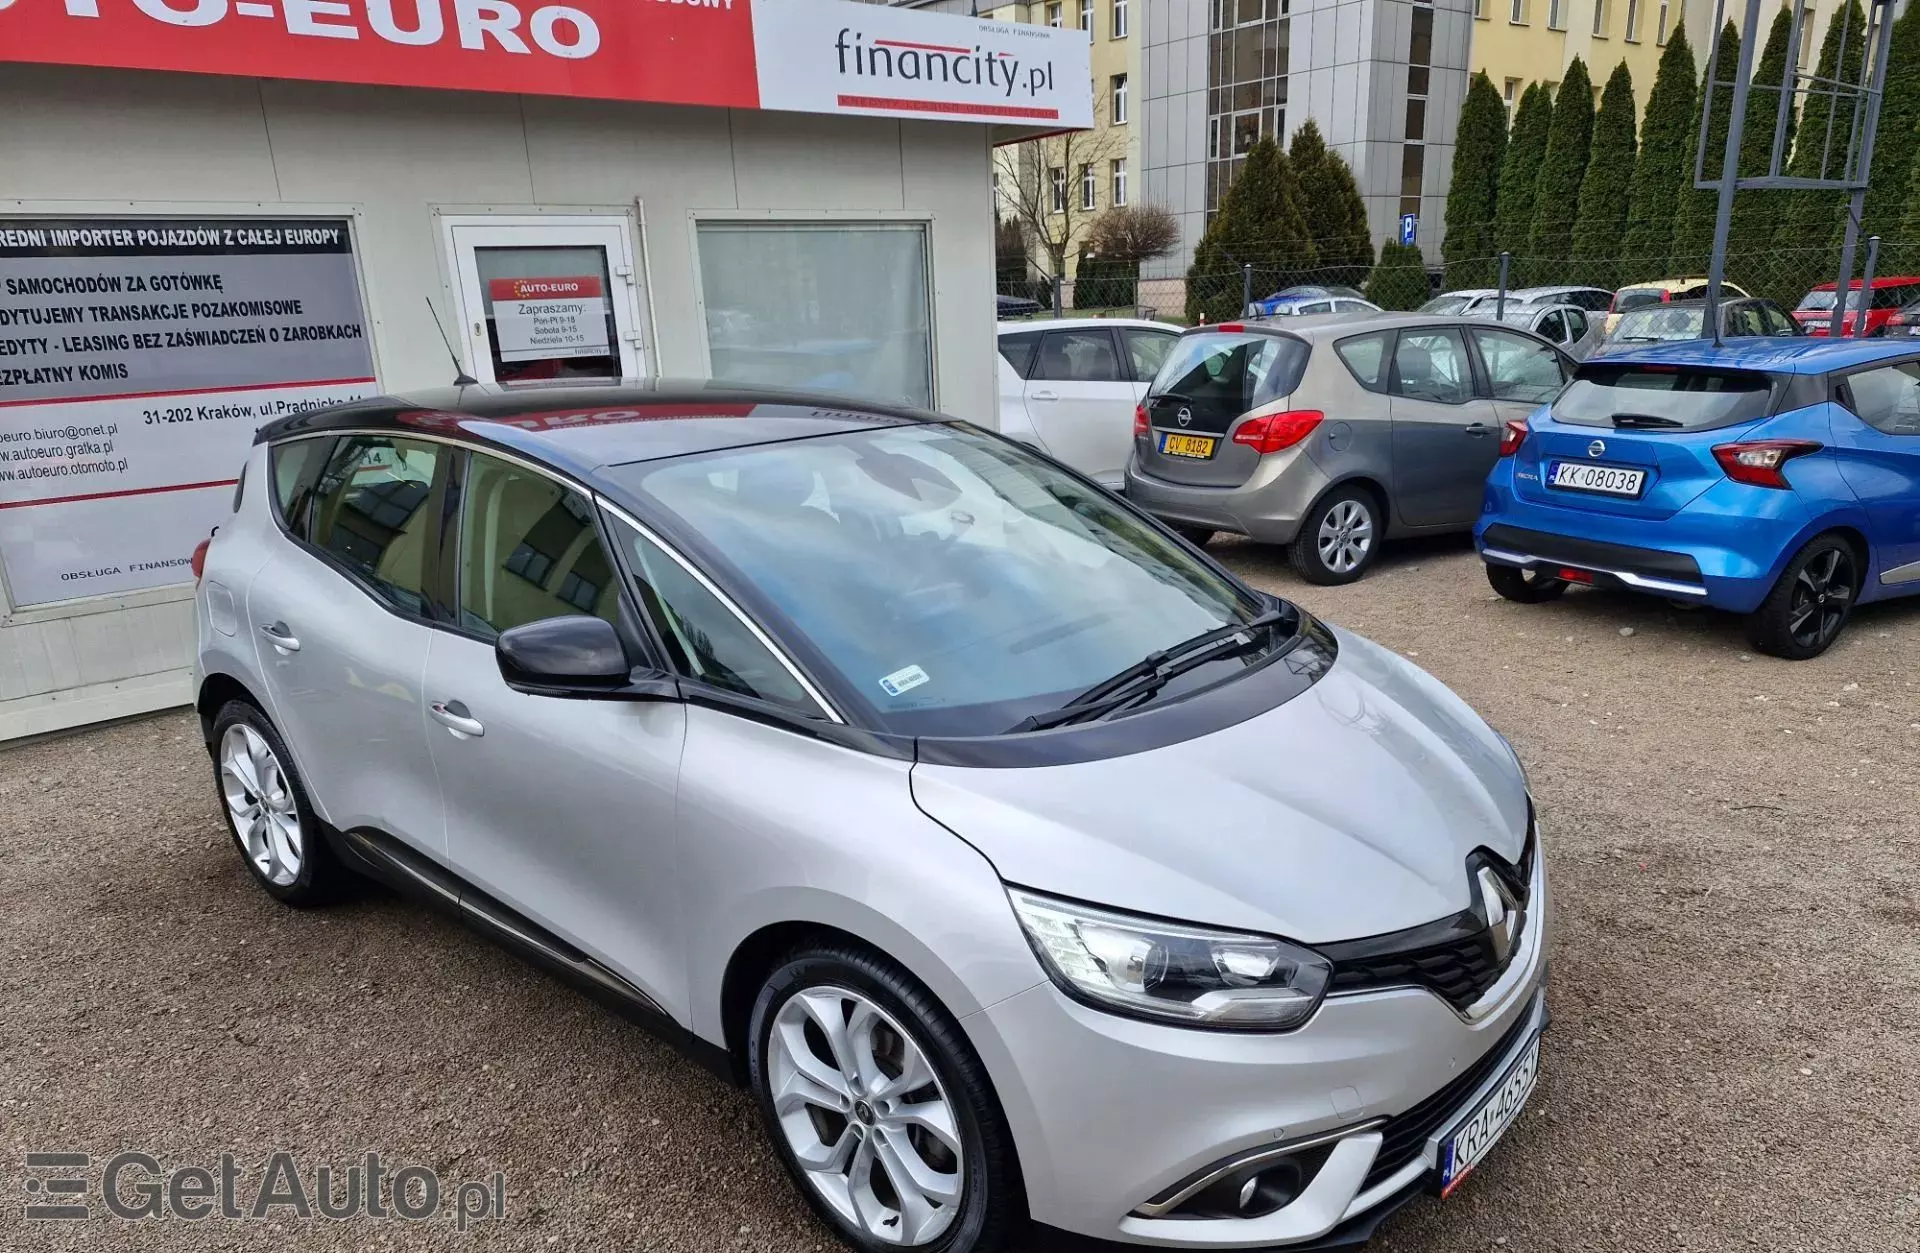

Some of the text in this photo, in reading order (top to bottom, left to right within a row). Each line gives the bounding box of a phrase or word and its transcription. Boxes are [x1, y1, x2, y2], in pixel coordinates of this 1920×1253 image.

[835, 28, 1053, 97] financity.pl
[50, 229, 135, 246] IMPORTER
[137, 226, 220, 246] POJAZDÓW
[224, 229, 235, 246] Z
[236, 229, 282, 245] CAŁEJ
[284, 229, 339, 245] EUROPY
[6, 272, 223, 295] SAMOCHODÓW ZA GOTÓWKĘ
[520, 282, 578, 293] AUTO-EURO
[88, 303, 188, 323] TRANSAKCJE
[192, 300, 303, 319] POZAKOMISOWE
[518, 303, 587, 316] Zapraszamy:
[62, 334, 130, 353] LEASING
[132, 332, 162, 349] BEZ
[165, 325, 266, 348] ZAŚWIADCZEŃ
[270, 327, 279, 342] O
[282, 324, 362, 342] ZAROBKACH
[530, 336, 563, 345] Niedziela
[534, 326, 560, 335] Sobota
[78, 363, 129, 381] KOMIS
[142, 407, 194, 425] 31-202
[197, 403, 256, 420] Kraków,
[1169, 437, 1209, 454] CV 8182
[1558, 467, 1638, 491] KK 08038
[61, 567, 122, 581] OBSŁUGA
[1454, 1108, 1489, 1174] KRA
